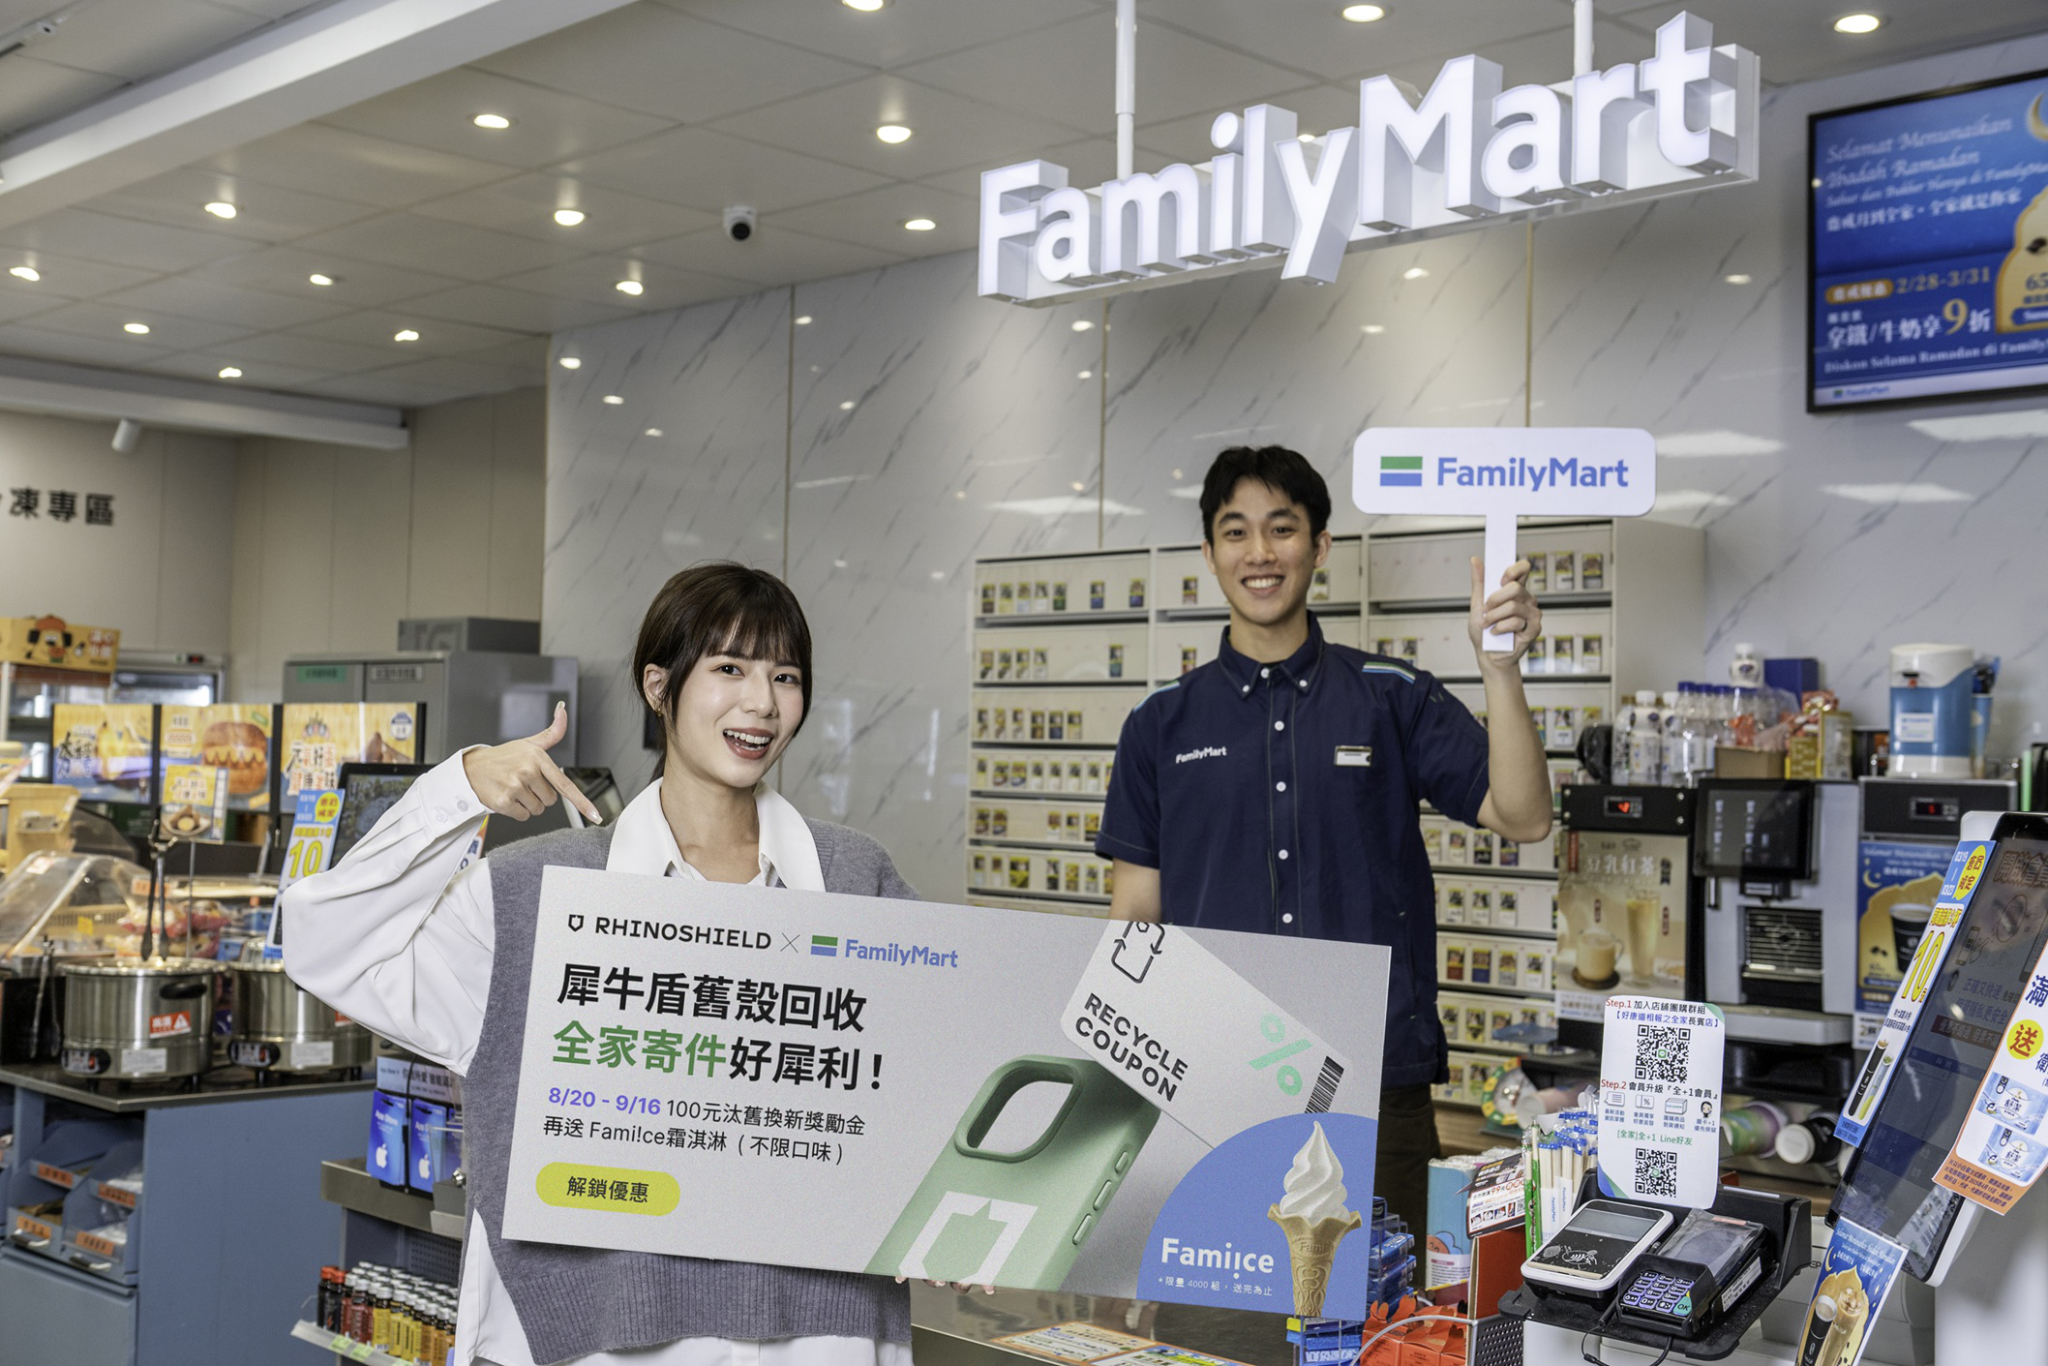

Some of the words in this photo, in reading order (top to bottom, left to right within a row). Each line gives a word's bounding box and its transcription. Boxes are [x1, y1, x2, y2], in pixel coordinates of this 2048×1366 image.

[978, 10, 1725, 298] FamilyMart
[1897, 266, 1991, 294] 2/28-3/31
[1437, 457, 1629, 491] FamilyMart
[0, 486, 116, 527] 凍專區
[1175, 746, 1227, 764] FamilyMart
[594, 917, 772, 950] RHINOSHIELD
[845, 938, 959, 968] FamilyMart
[557, 963, 867, 1033] 犀牛盾舊殼回收
[1605, 999, 1632, 1010] Step.1
[1083, 992, 1189, 1081] RECYCLE
[2009, 1024, 2038, 1057] 送
[1075, 1016, 1177, 1102] COUPON
[1601, 1078, 1627, 1090] Step.2
[543, 1115, 584, 1138] 再送
[548, 1087, 596, 1108] 8/20
[615, 1094, 661, 1115] 9/16
[667, 1100, 866, 1136] 100元汰舊換新獎勵金
[566, 1175, 649, 1203] 解鎖優惠
[1187, 1280, 1209, 1290] 4000
[1677, 1303, 1690, 1311] OK
